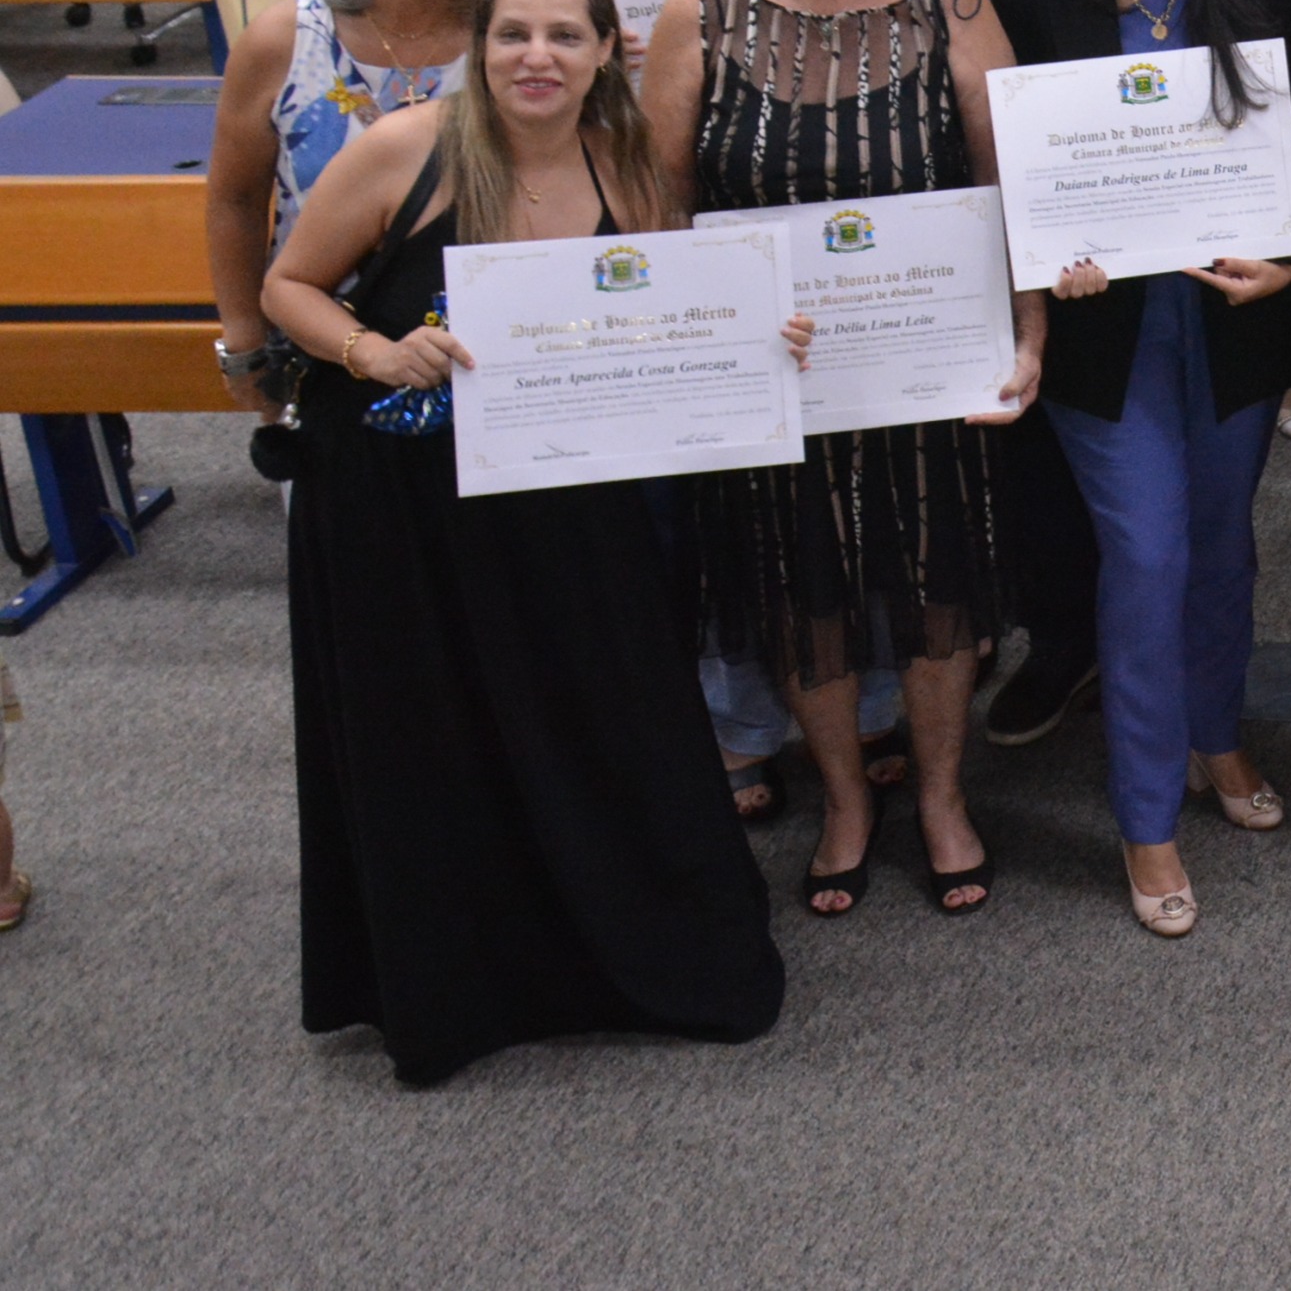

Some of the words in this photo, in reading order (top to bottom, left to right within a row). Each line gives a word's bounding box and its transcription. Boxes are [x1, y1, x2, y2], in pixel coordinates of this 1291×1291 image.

[1046, 130, 1107, 148] Diploma
[1110, 127, 1126, 141] de
[1130, 122, 1175, 138] Honra
[1178, 120, 1193, 133] ao
[1071, 143, 1114, 161] Câmara
[1116, 140, 1167, 156] Municipal
[1169, 137, 1181, 149] de
[1054, 176, 1098, 193] Daiana
[1101, 169, 1161, 188] Rodrigues
[1163, 168, 1177, 181] de
[1180, 164, 1210, 178] Lima
[1213, 161, 1248, 176] Braga
[814, 274, 831, 291] de
[834, 272, 881, 290] Honra
[884, 270, 901, 284] ao
[904, 263, 954, 283] Mérito
[818, 289, 874, 308] Municipal
[875, 287, 888, 301] de
[890, 283, 934, 300] Goiânia
[508, 320, 577, 340] Diploma
[580, 317, 598, 332] de
[604, 313, 656, 331] Honra
[659, 310, 678, 325] ao
[683, 304, 737, 324] Mérito
[834, 318, 867, 334] Délia
[870, 317, 902, 331] Lima
[904, 312, 935, 328] Leite
[534, 338, 583, 354] Câmara
[586, 333, 648, 350] Municipal
[666, 327, 714, 343] Goiânia
[514, 374, 562, 390] Suelen
[565, 367, 634, 387] Aparecida
[637, 362, 675, 378] Costa
[679, 358, 738, 377] Gonzaga
